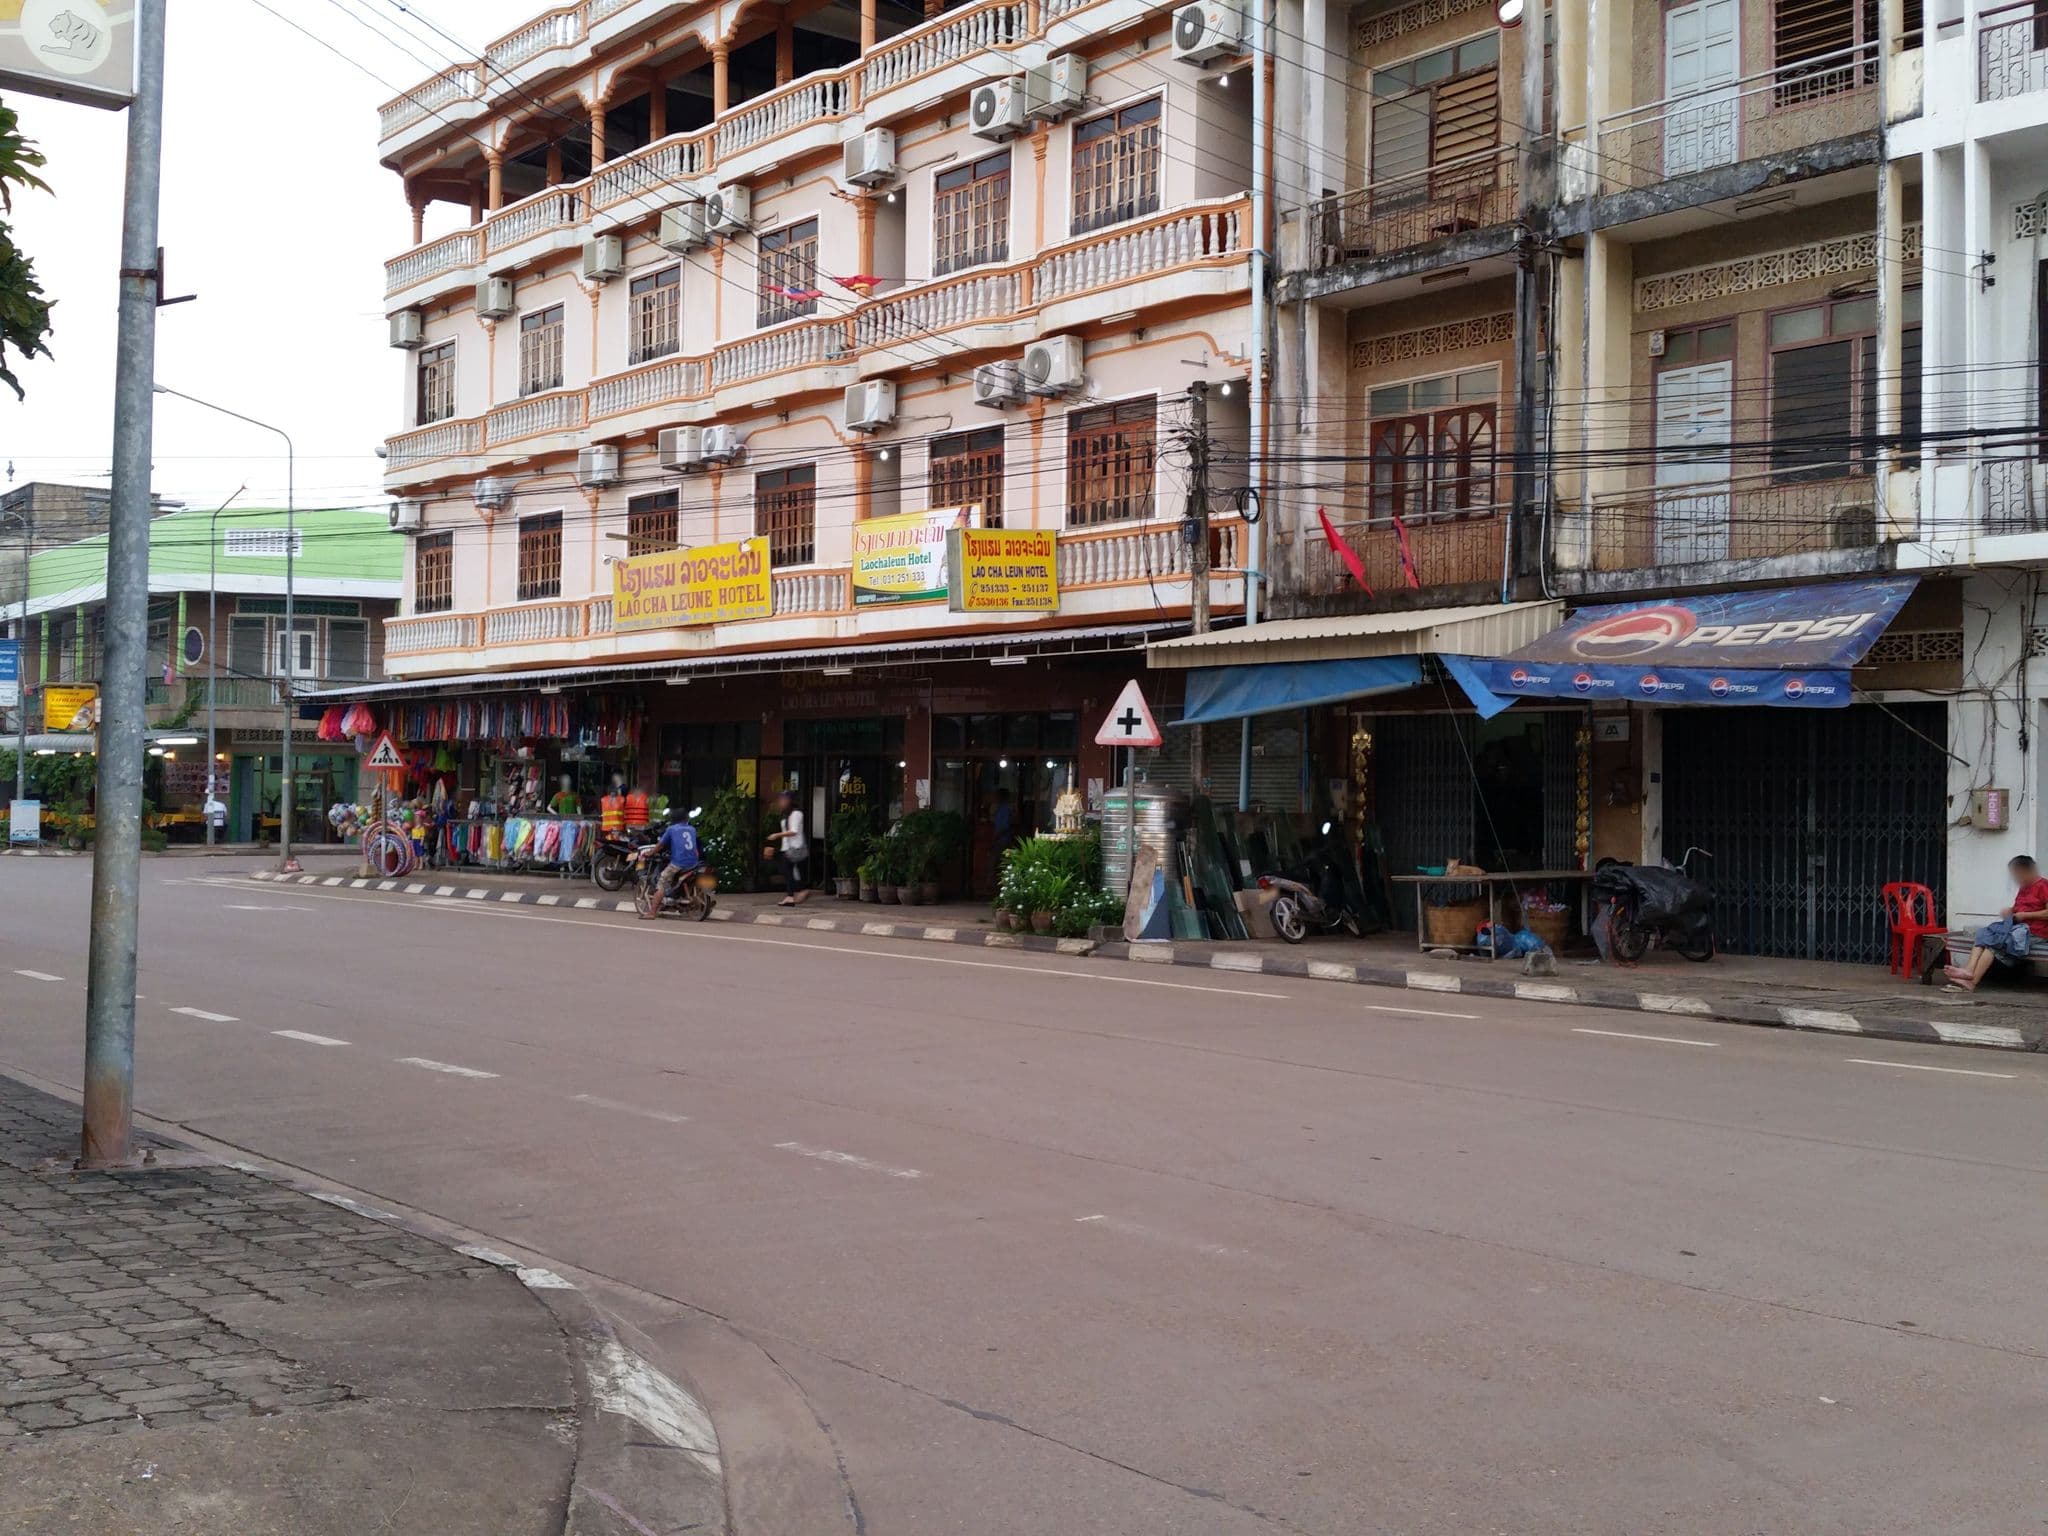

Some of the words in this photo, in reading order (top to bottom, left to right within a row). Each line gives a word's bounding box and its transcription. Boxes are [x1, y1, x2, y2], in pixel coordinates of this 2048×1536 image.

[861, 555, 906, 571] Laochaleun
[908, 551, 932, 566] Hotel
[971, 565, 986, 578] LAO
[988, 565, 1003, 578] CHA
[1005, 565, 1024, 578] LEUN
[1025, 565, 1049, 578] HOTEL
[883, 574, 895, 585] 031
[897, 572, 909, 583] 251
[911, 571, 926, 582] 333
[980, 583, 1010, 594] 251333
[1021, 583, 1049, 594] 251137
[618, 599, 641, 618] LAO
[642, 595, 668, 614] CHA
[671, 589, 713, 612] LEUNE
[719, 583, 766, 606] HOTEL
[1674, 612, 1877, 648] PEPSI
[1527, 675, 1551, 685] PEPSI
[1591, 679, 1615, 688] PEPSI
[1659, 682, 1685, 691] PEPSI
[1728, 684, 1759, 693] PEPSI
[1804, 686, 1836, 695] PEPSI
[682, 831, 694, 851] 3
